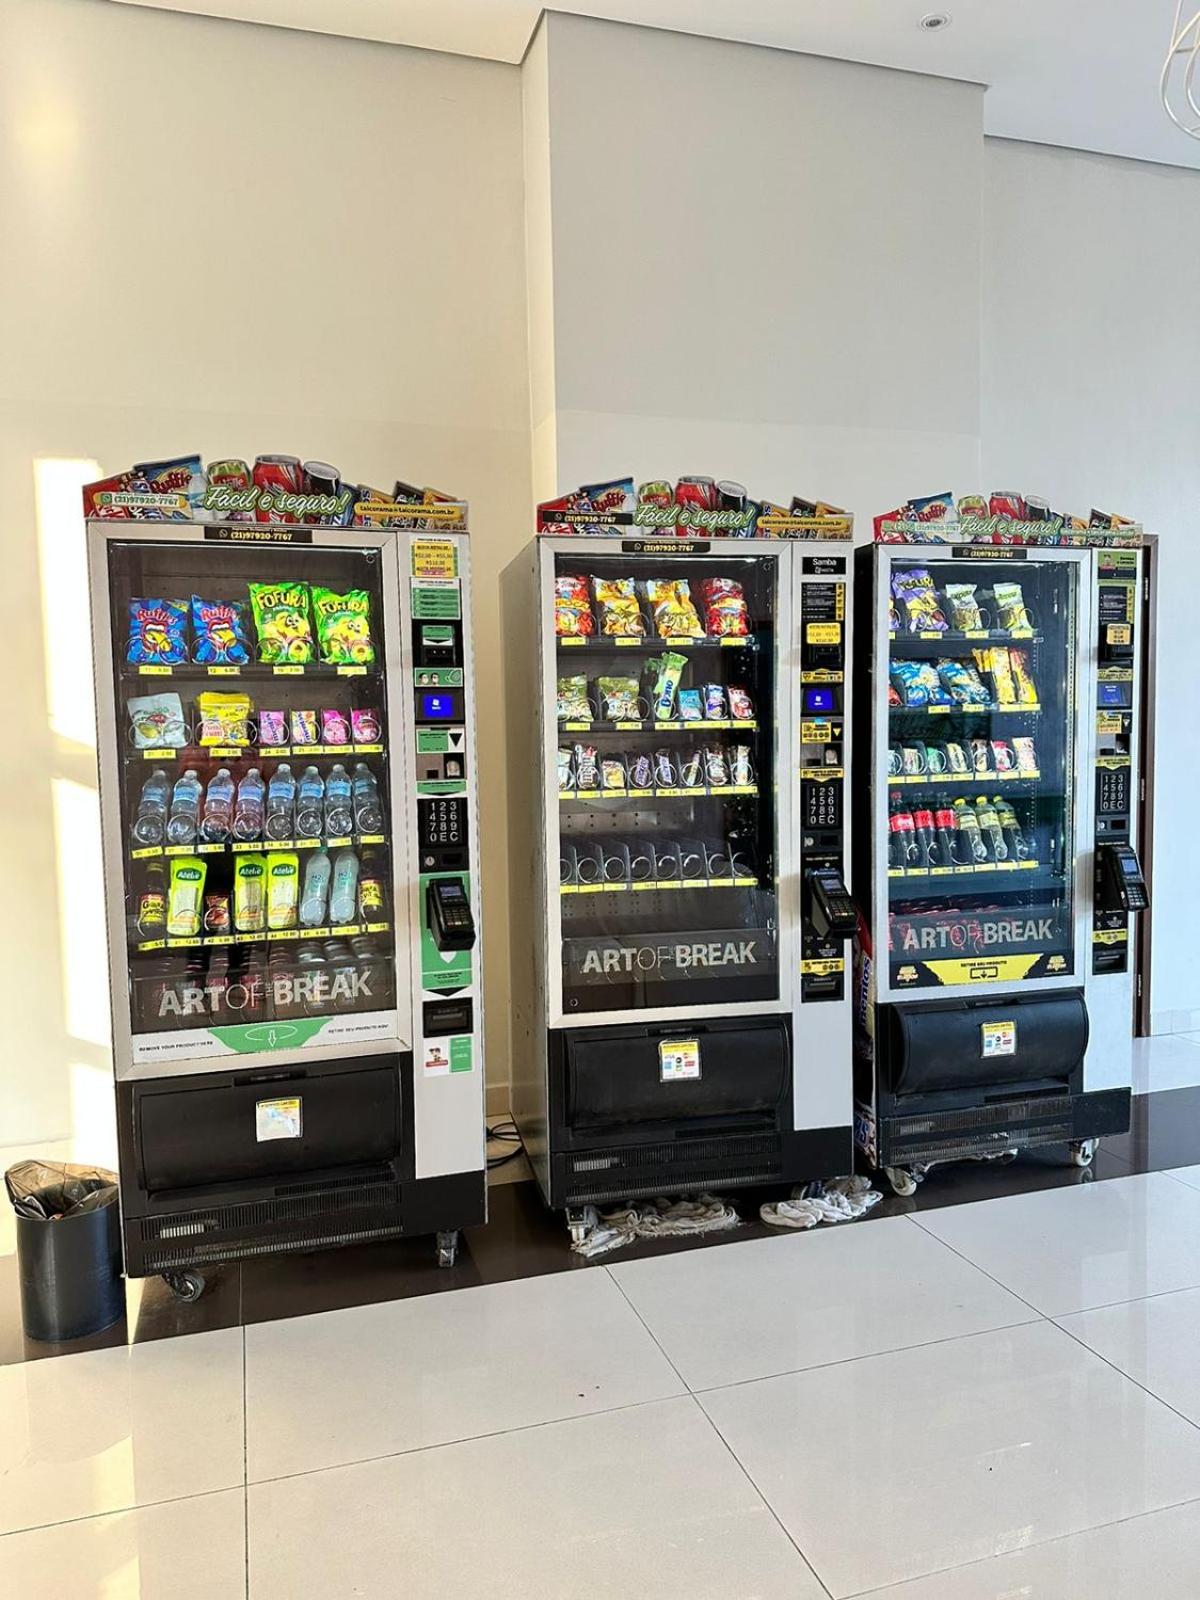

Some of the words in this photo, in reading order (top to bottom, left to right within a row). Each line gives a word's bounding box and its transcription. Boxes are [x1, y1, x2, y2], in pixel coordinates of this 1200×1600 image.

[206, 486, 259, 509] Fácil
[260, 493, 273, 508] e
[277, 494, 348, 515] seguro!
[637, 504, 675, 524] Fácil
[679, 511, 691, 523] e
[694, 507, 755, 530] seguro!
[961, 514, 997, 532] Fácil
[1010, 516, 1062, 538] seguro!
[812, 558, 837, 566] Samba
[256, 590, 306, 610] FOFURA
[319, 600, 368, 615] FOFURA
[903, 926, 950, 950] ART
[984, 919, 1053, 944] BREAK
[582, 948, 637, 974] ART
[675, 941, 757, 968] BREAK
[159, 984, 225, 1017] ART
[274, 970, 373, 1006] BREAK
